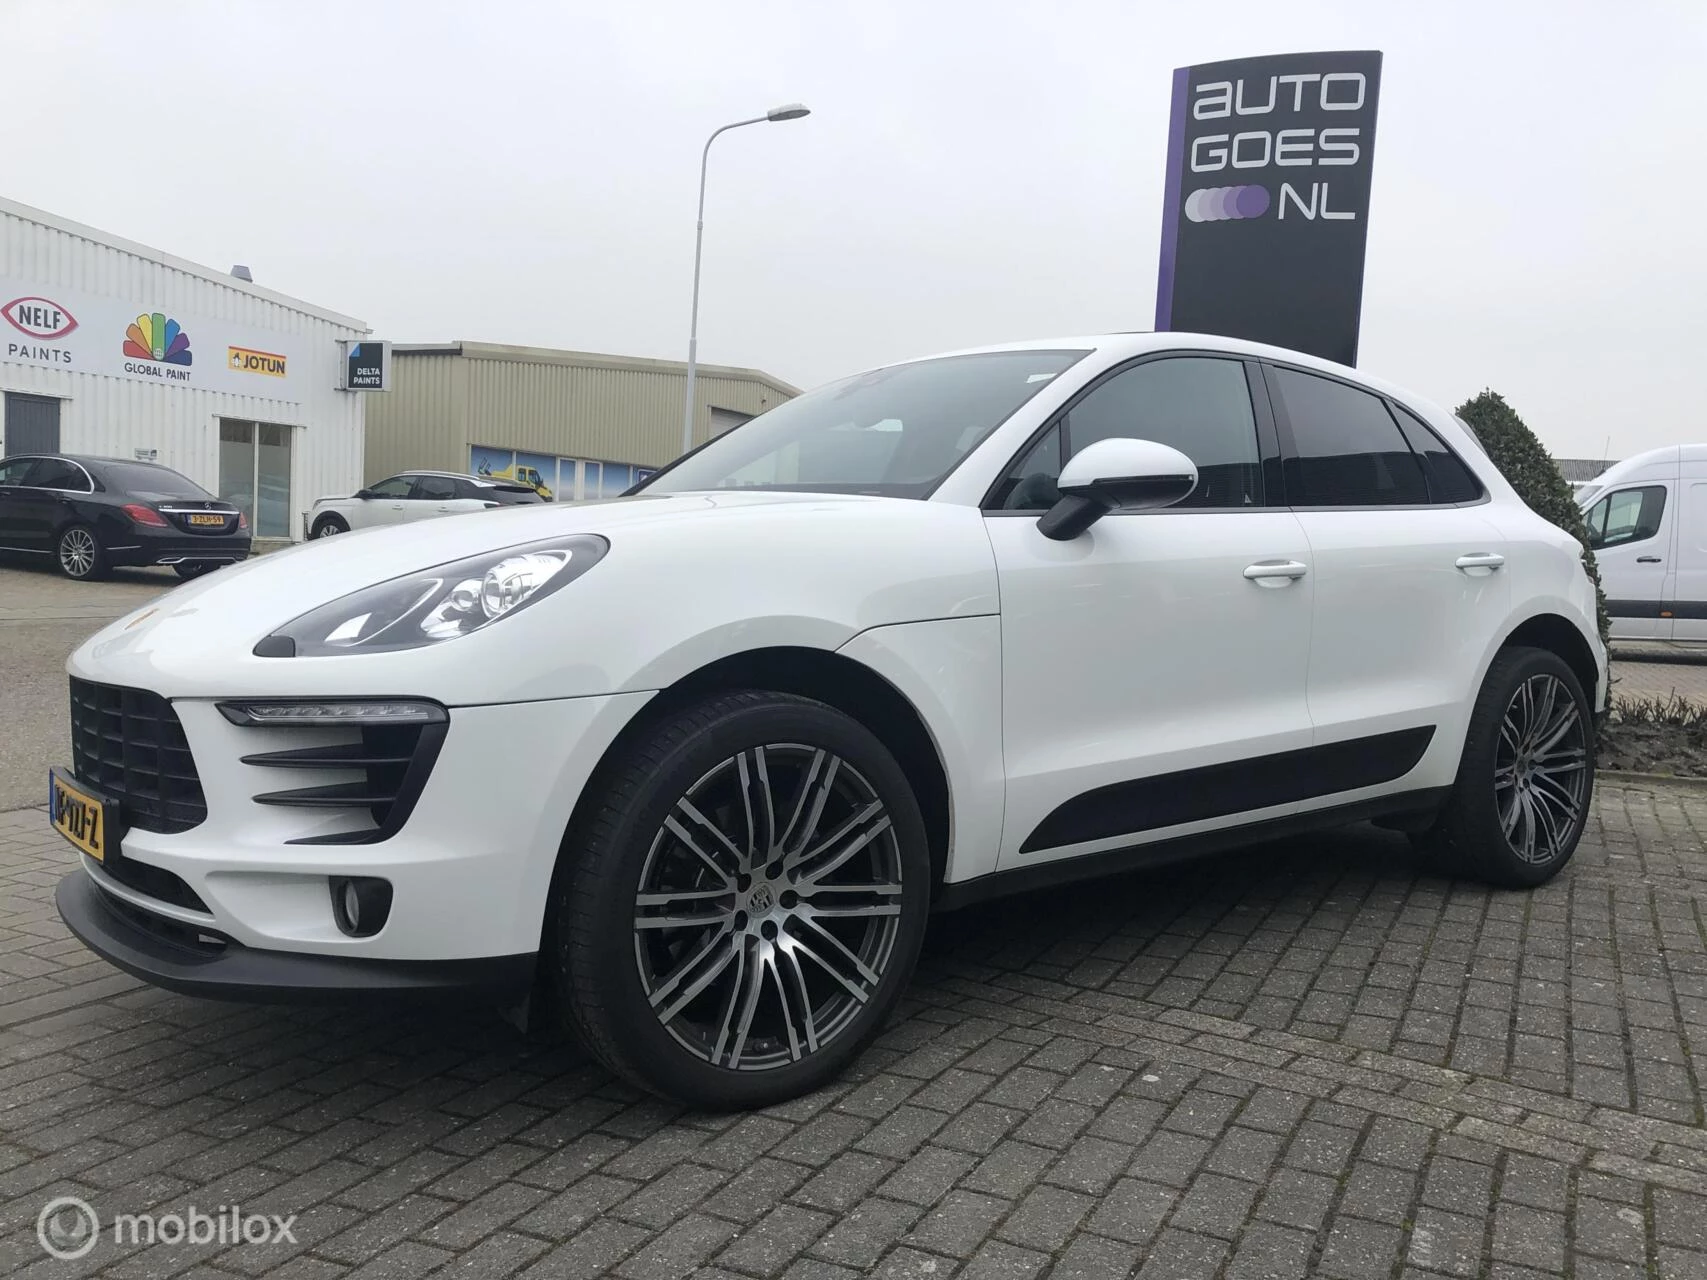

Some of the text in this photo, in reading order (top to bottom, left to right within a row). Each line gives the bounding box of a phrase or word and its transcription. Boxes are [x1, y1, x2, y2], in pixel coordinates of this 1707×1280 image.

[1190, 127, 1360, 173] GOES
[1278, 182, 1356, 221] NL
[19, 304, 61, 330] NELF
[8, 343, 72, 363] PAINTS
[124, 362, 192, 381] GLOBAL PAINT
[243, 354, 286, 374] JOTUN
[357, 367, 381, 376] DELTA
[353, 376, 381, 385] PAINTS
